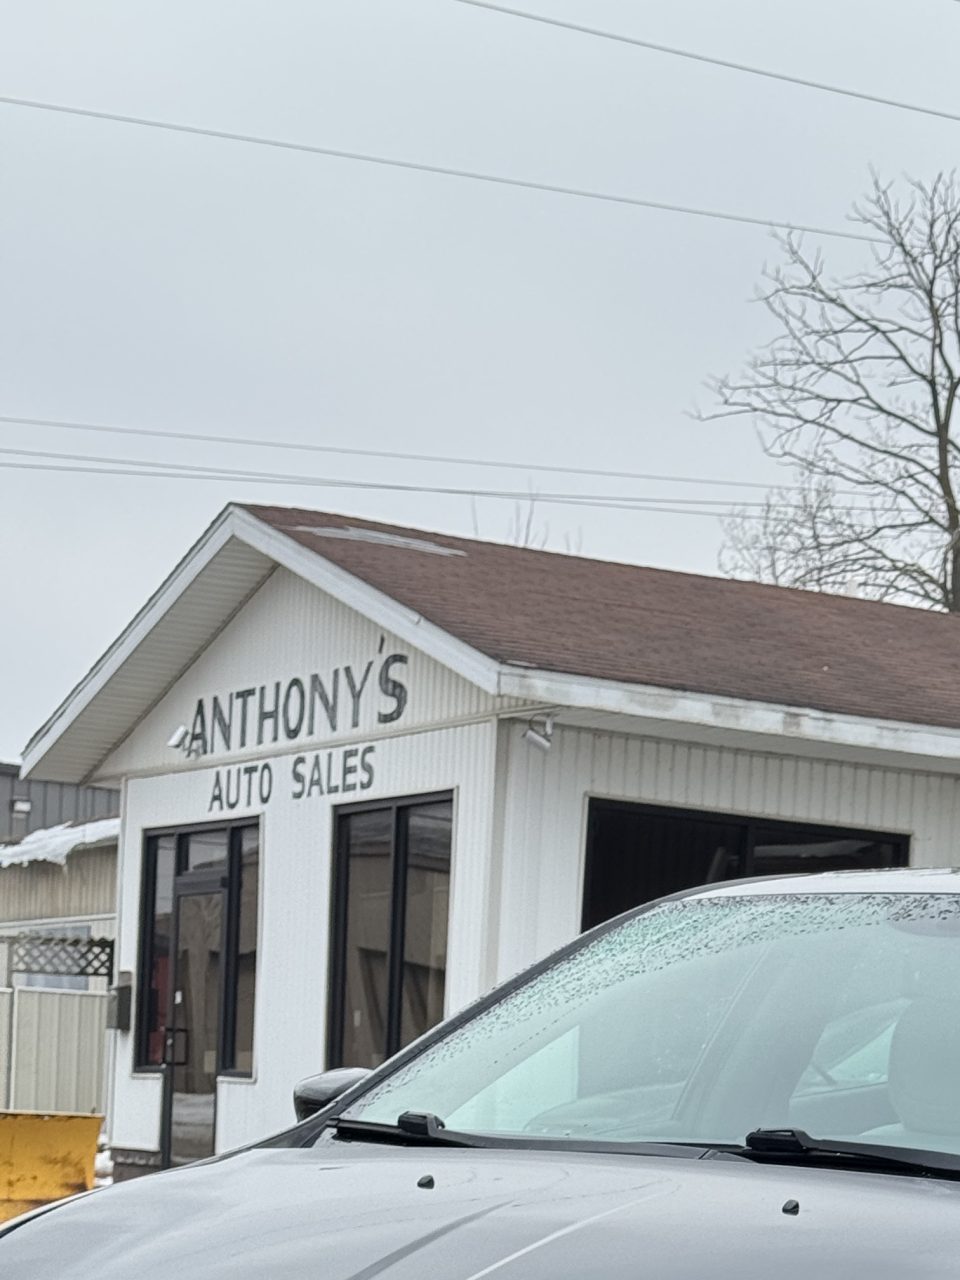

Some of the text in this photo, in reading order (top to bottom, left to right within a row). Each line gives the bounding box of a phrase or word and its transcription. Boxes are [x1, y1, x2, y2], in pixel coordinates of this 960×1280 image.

[186, 634, 408, 758] ANTHONY'S
[208, 746, 375, 812] AUTO SALES
